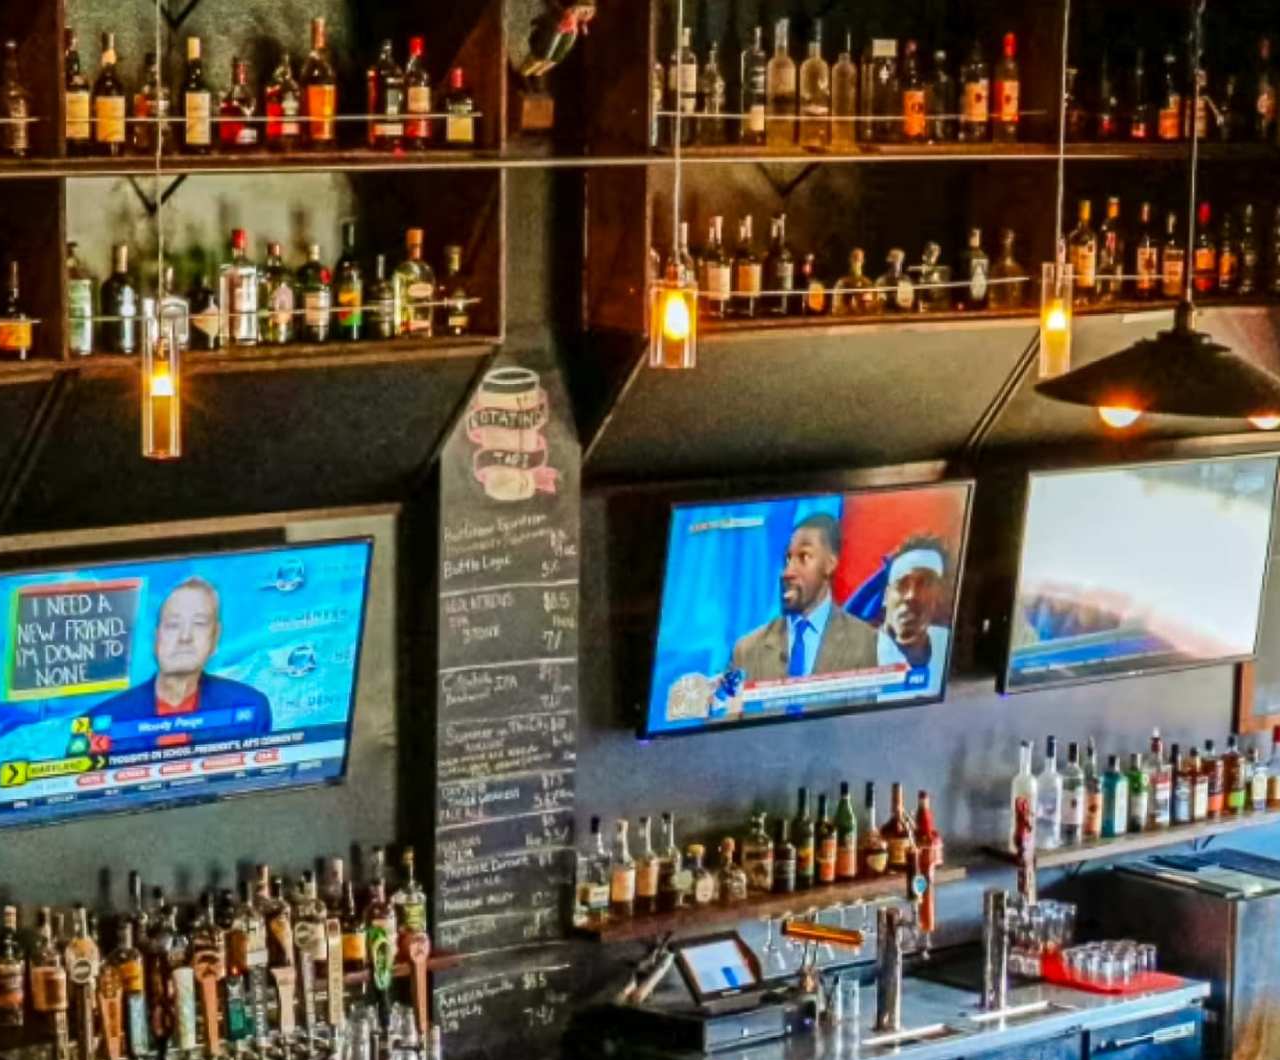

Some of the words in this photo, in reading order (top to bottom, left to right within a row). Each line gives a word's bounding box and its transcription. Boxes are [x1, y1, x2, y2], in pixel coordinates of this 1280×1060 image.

[46, 594, 92, 617] NEED
[97, 592, 113, 613] A
[17, 621, 56, 645] NEW
[45, 641, 95, 665] DOWN
[102, 638, 124, 660] TO
